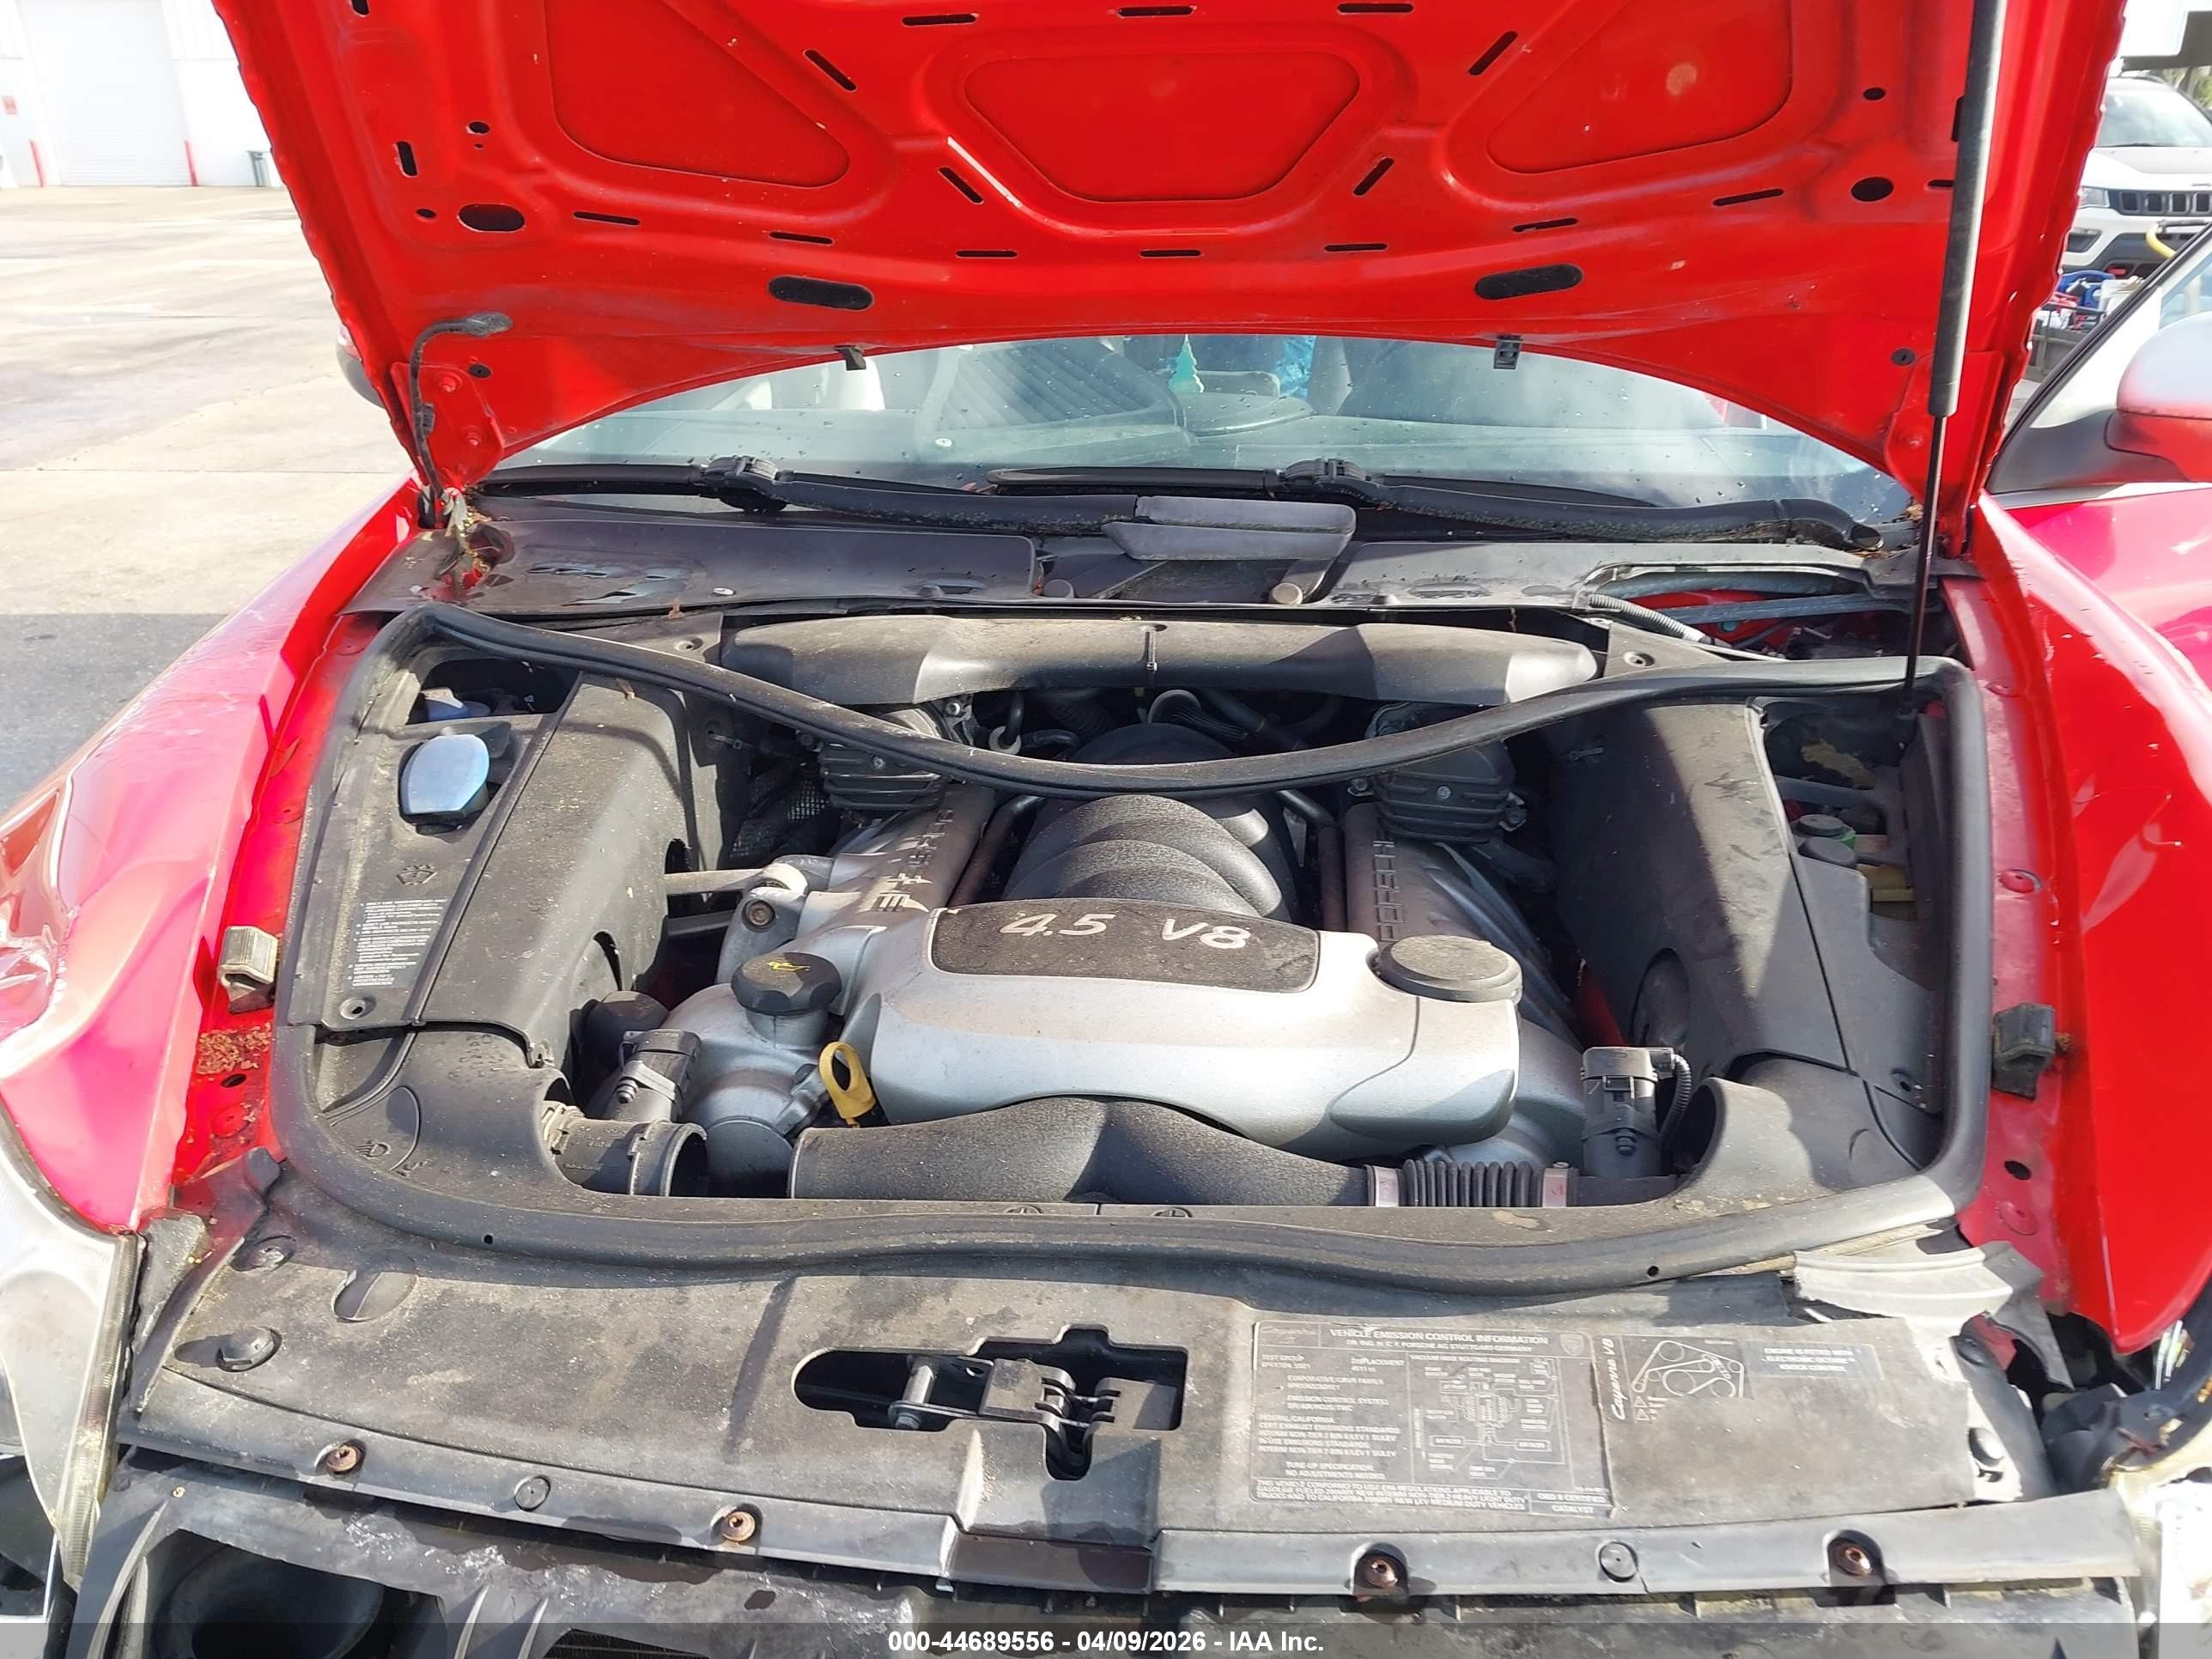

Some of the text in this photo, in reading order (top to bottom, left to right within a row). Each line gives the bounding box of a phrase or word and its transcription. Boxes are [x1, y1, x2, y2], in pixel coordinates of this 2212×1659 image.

[999, 913, 1252, 949] 4.5 V8
[1329, 1328, 1373, 1340] VEHICLE
[1373, 1330, 1425, 1340] EMISSION
[1425, 1332, 1475, 1342] CONTROL
[1475, 1334, 1549, 1345] INFORMATION
[1607, 1359, 1629, 1420] Cayenne
